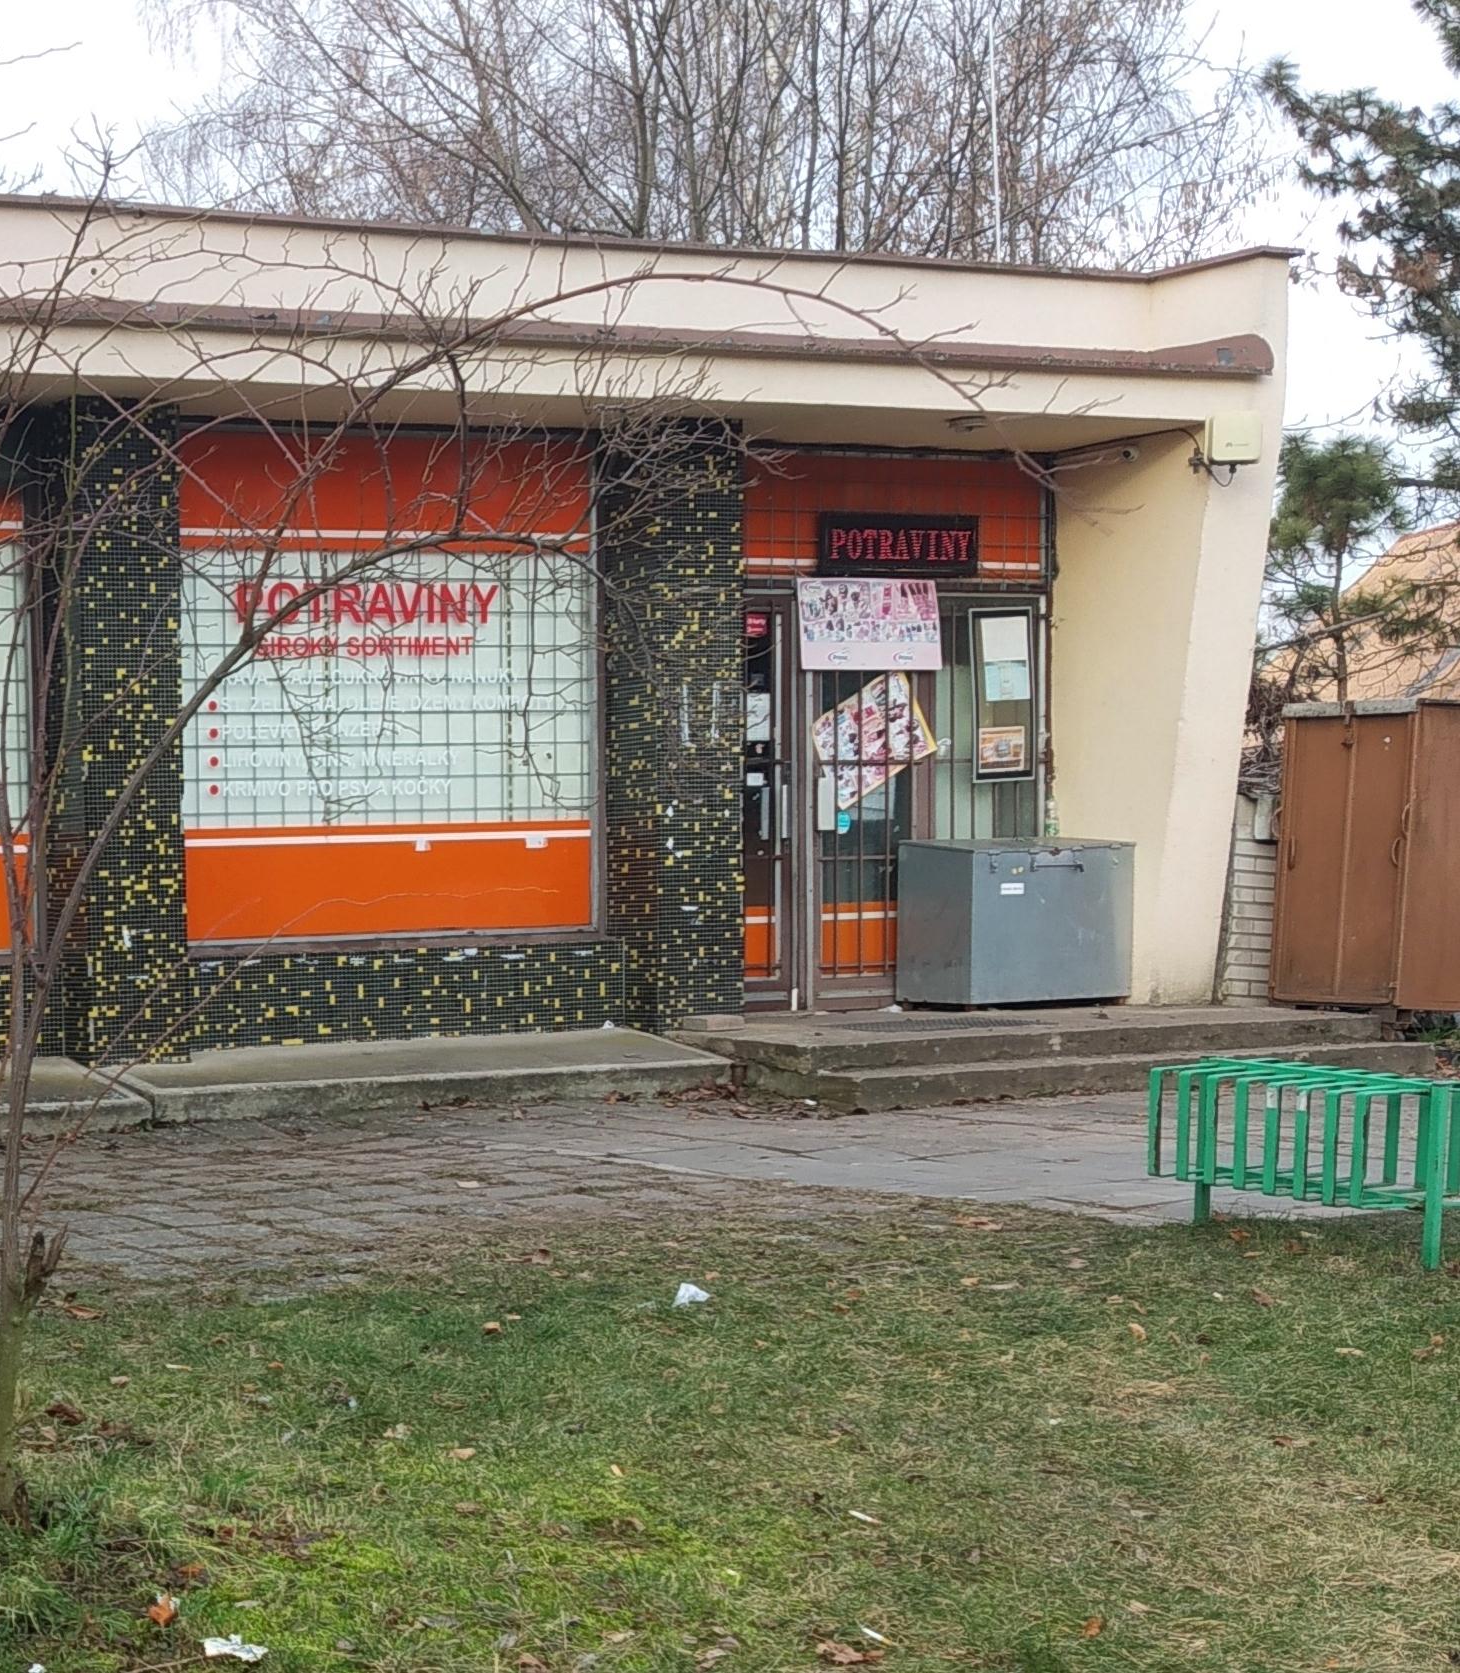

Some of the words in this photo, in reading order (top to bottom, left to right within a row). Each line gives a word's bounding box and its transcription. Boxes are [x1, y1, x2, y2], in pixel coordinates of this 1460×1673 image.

[830, 528, 972, 561] POTRAVINY
[234, 580, 500, 625] POTRAVINY
[347, 635, 475, 657] SORTIMENT
[222, 780, 291, 797] KRMIVO
[296, 780, 333, 797] PRO
[338, 779, 373, 796] PSY
[392, 775, 453, 796] KOČKY
